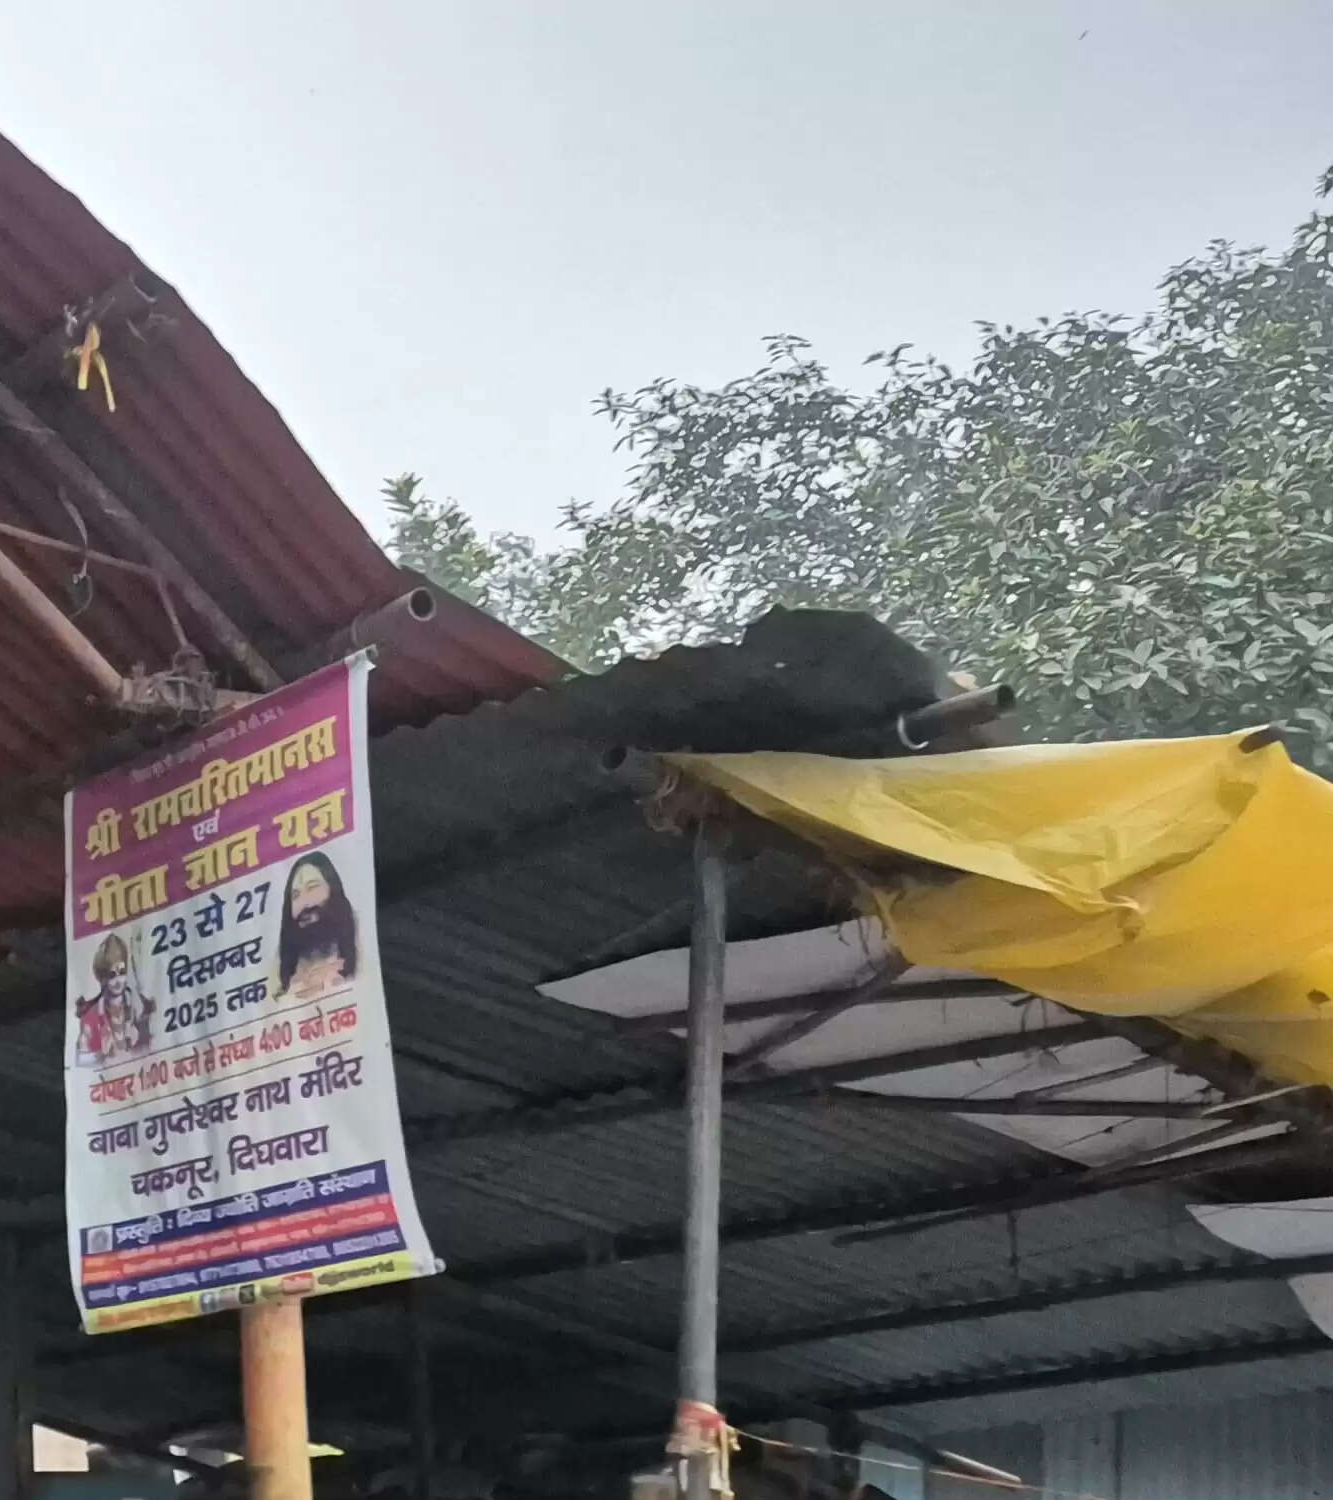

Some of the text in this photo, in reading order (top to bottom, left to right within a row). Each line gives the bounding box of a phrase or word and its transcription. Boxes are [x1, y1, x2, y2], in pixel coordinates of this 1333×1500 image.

[85, 807, 122, 859] श्री
[131, 715, 337, 841] रामचरितमानस
[80, 788, 346, 926] गीता ज्ञान यज्ञ
[151, 881, 271, 956] 23 से 27
[167, 936, 263, 994] दिसम्बर
[164, 976, 268, 1033] 2025 तक
[245, 1077, 291, 1113] नाथ
[298, 1051, 363, 1098] मंदिर
[227, 1125, 330, 1176] दिघवारा
